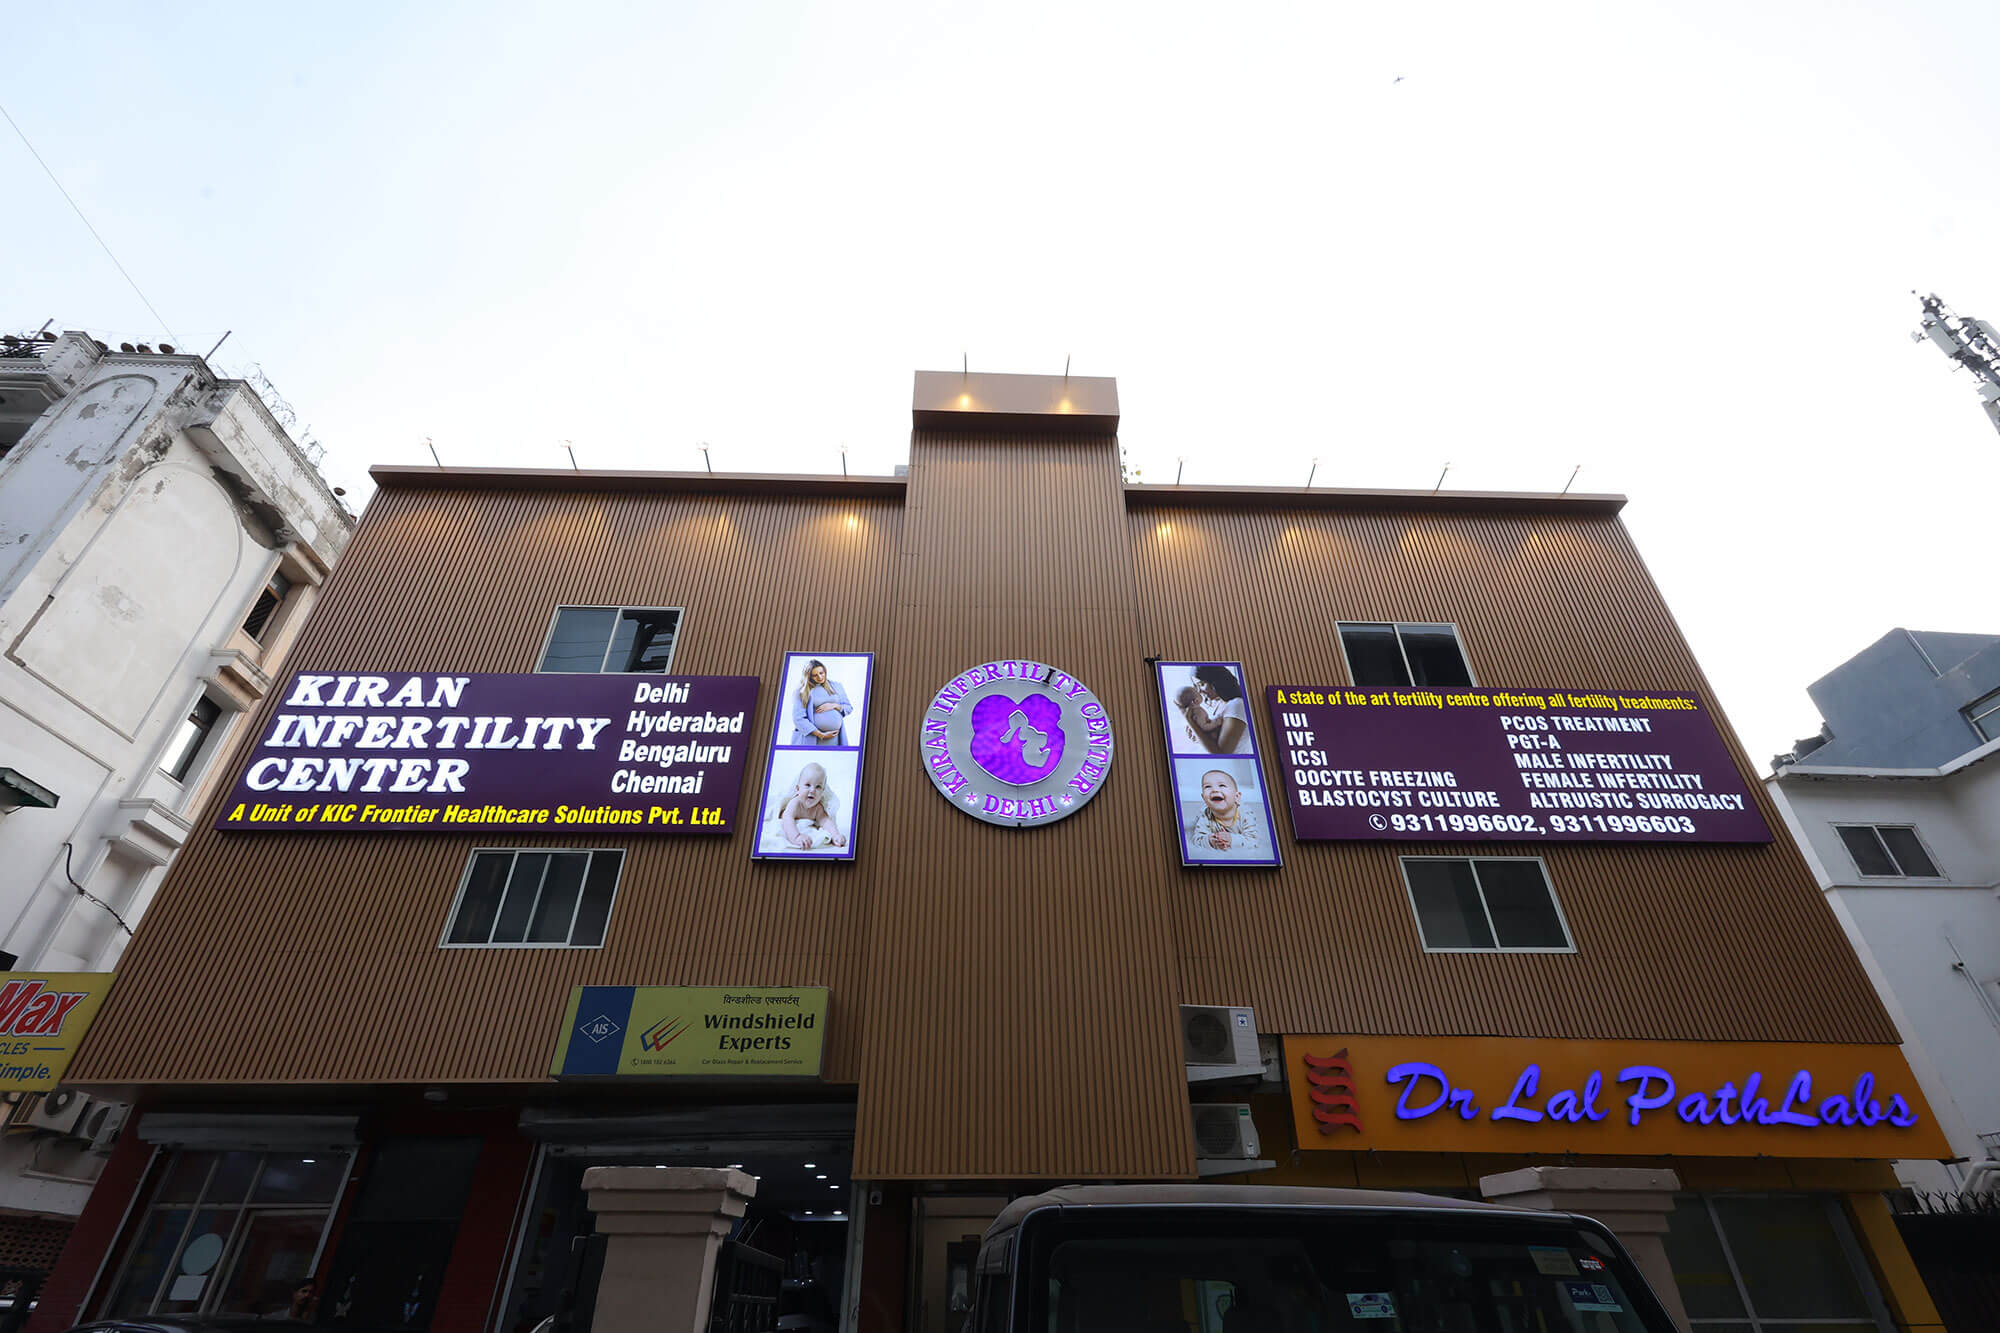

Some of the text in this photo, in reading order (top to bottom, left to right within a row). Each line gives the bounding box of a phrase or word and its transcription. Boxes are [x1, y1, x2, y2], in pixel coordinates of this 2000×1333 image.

[285, 675, 470, 708] KIRAN
[634, 682, 690, 703] Delhi
[1277, 690, 1698, 711] A state of the art fertility centre offering all fertility treatments:
[626, 710, 744, 737] Hyderabad
[925, 661, 1110, 795] KIRAN INFERTILITY CENTER
[1282, 712, 1308, 727] IUI
[1500, 715, 1652, 732] PCOS TREATMENT
[264, 715, 611, 750] INFERTILITY
[1286, 731, 1315, 746] IVF
[1506, 734, 1561, 749] PGT-A
[618, 740, 731, 768] Bengaluru
[1290, 749, 1328, 766] ICSI
[1513, 753, 1673, 770] MALE INFERTILITY
[246, 757, 470, 792] CENTER
[611, 769, 704, 794] Chennai
[1294, 769, 1457, 787] OOCYTE FREEZING
[1520, 772, 1704, 790] FEMALE INFERTILITY
[982, 794, 1058, 819] DELHI
[1298, 790, 1500, 808] BLASTOCYST CULTURE
[1530, 792, 1744, 810] ALTRUISTIC SURROGACY
[228, 803, 726, 825] A Unit of KIC Frontier Healthcare Solutions Pvt. Ltd.
[1391, 814, 1696, 835] 9311996602, 9311996603
[0, 980, 88, 1036] Max
[592, 1024, 609, 1035] AIS
[704, 1013, 815, 1029] Windshield
[719, 1035, 791, 1053] Experts
[1387, 1062, 1918, 1127] Dr Lal PathLabs
